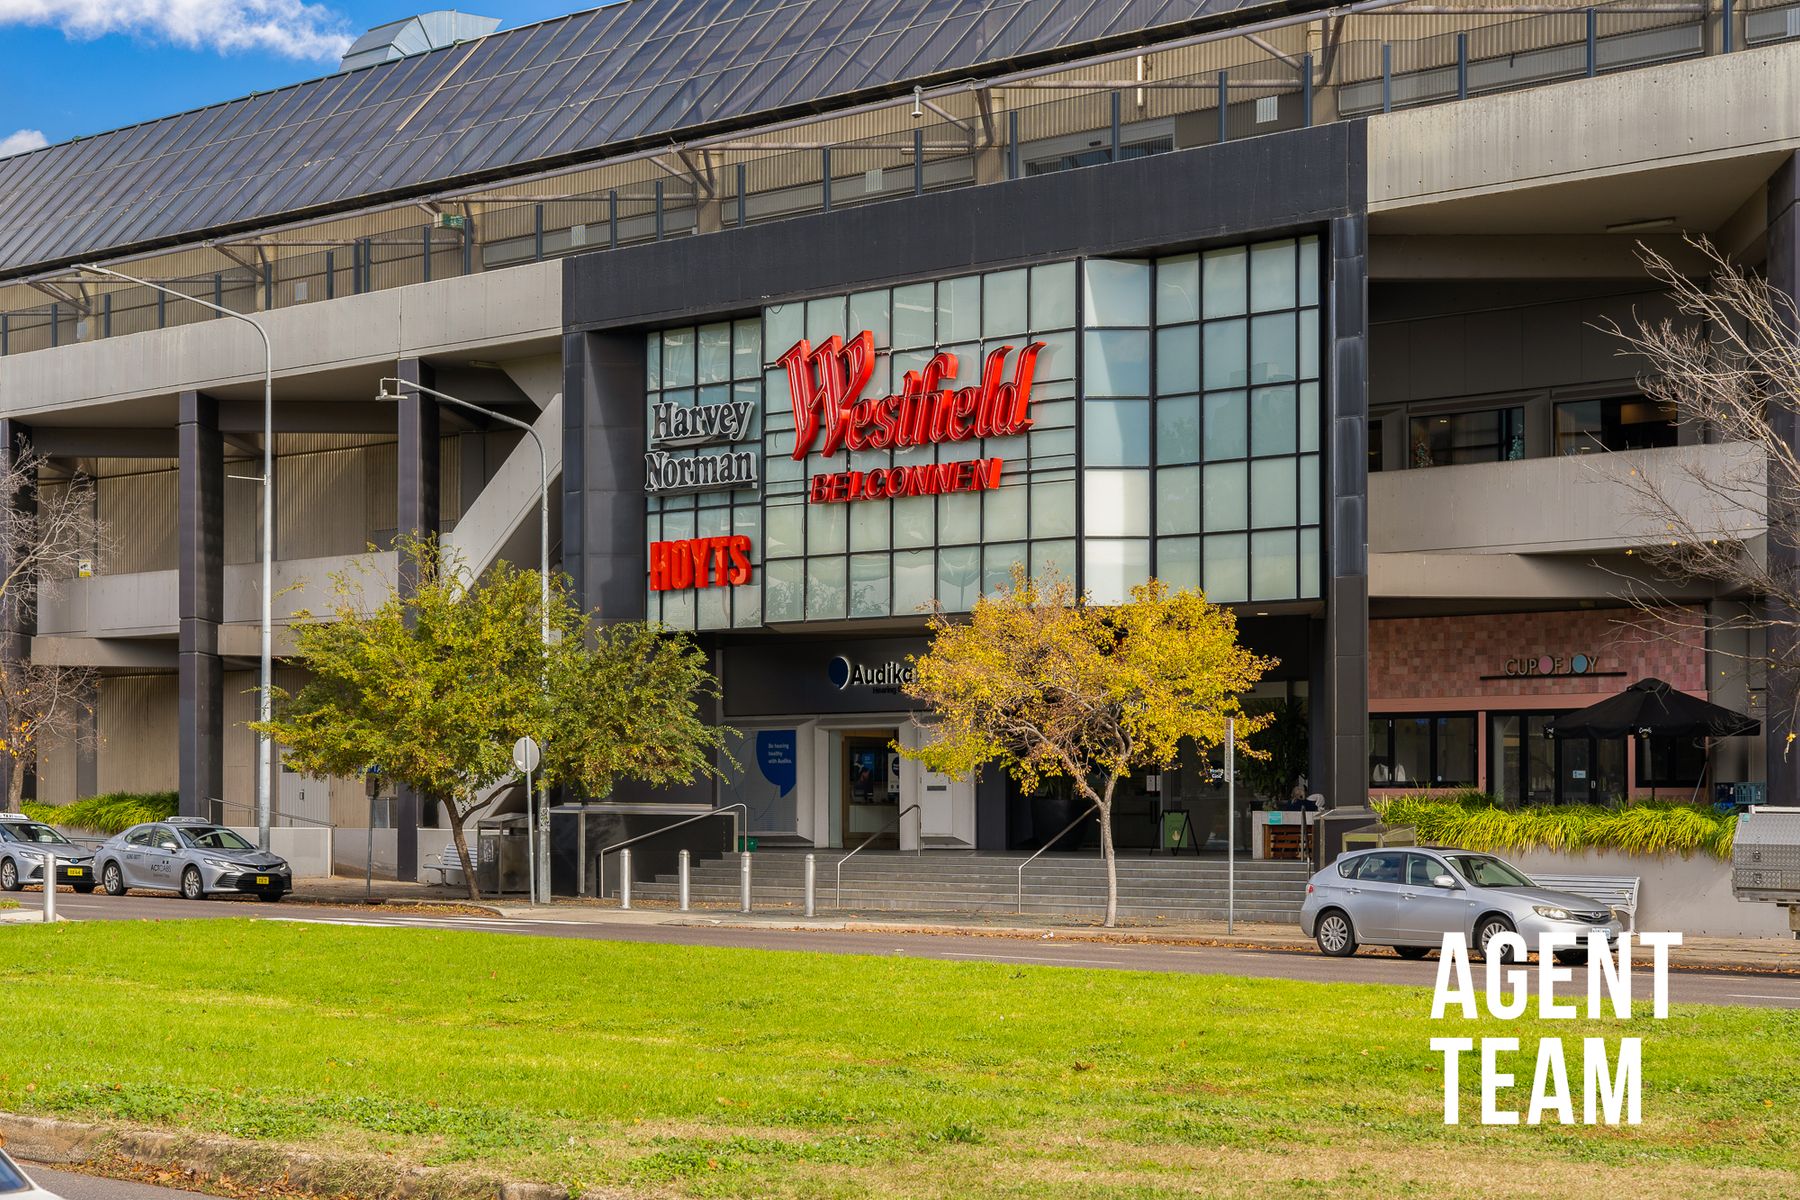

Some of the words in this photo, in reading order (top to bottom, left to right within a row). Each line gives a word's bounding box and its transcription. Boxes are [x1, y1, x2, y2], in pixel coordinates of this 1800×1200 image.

[776, 330, 1047, 461] Westfield
[651, 401, 755, 441] Harvey
[644, 451, 758, 491] Norman
[810, 457, 1004, 504] BELCONNEN
[650, 534, 753, 591] HOYTS
[1504, 658, 1538, 676] CUP
[1538, 655, 1564, 675] OF
[1565, 653, 1599, 674] JOY
